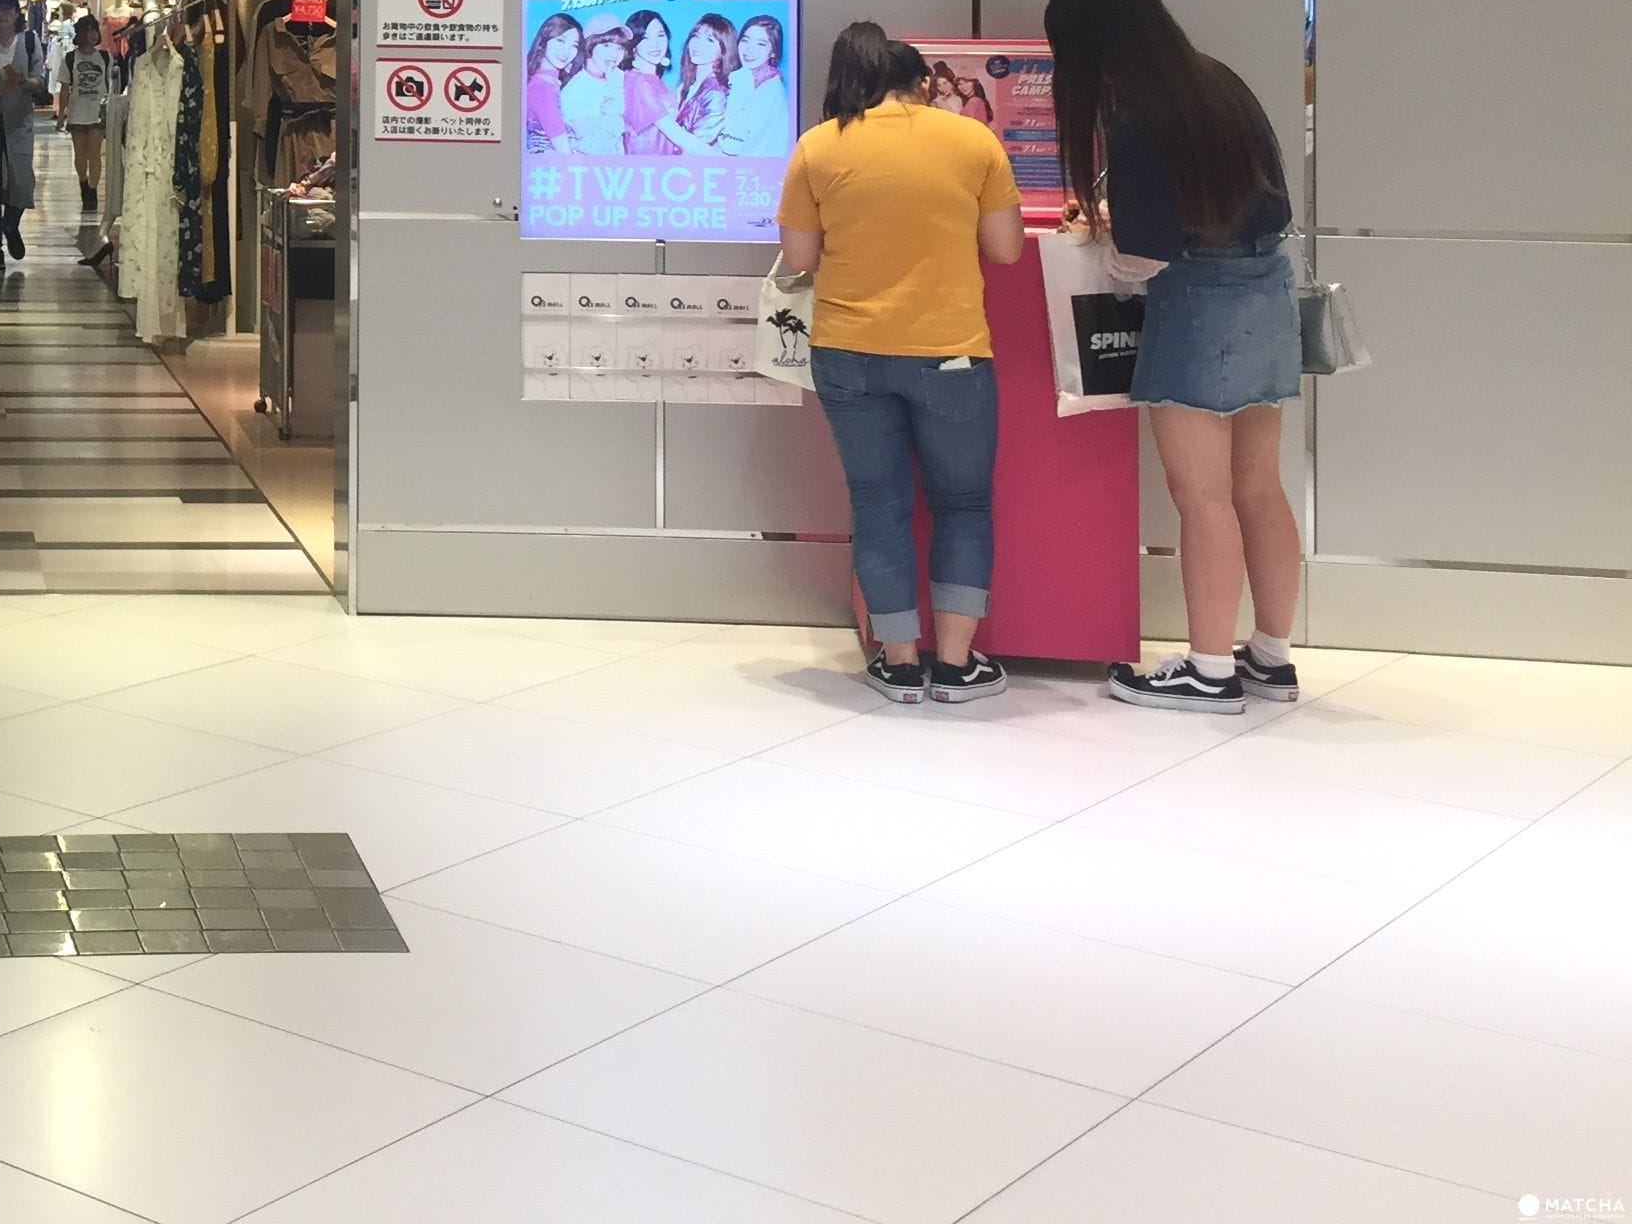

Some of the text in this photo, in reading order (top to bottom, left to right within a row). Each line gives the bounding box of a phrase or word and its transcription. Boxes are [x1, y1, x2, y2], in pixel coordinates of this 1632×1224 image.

[1017, 74, 1053, 85] PRES
[528, 166, 727, 203] #TWICE
[528, 204, 585, 227] POP
[592, 205, 629, 227] UP
[636, 206, 727, 229] STORE
